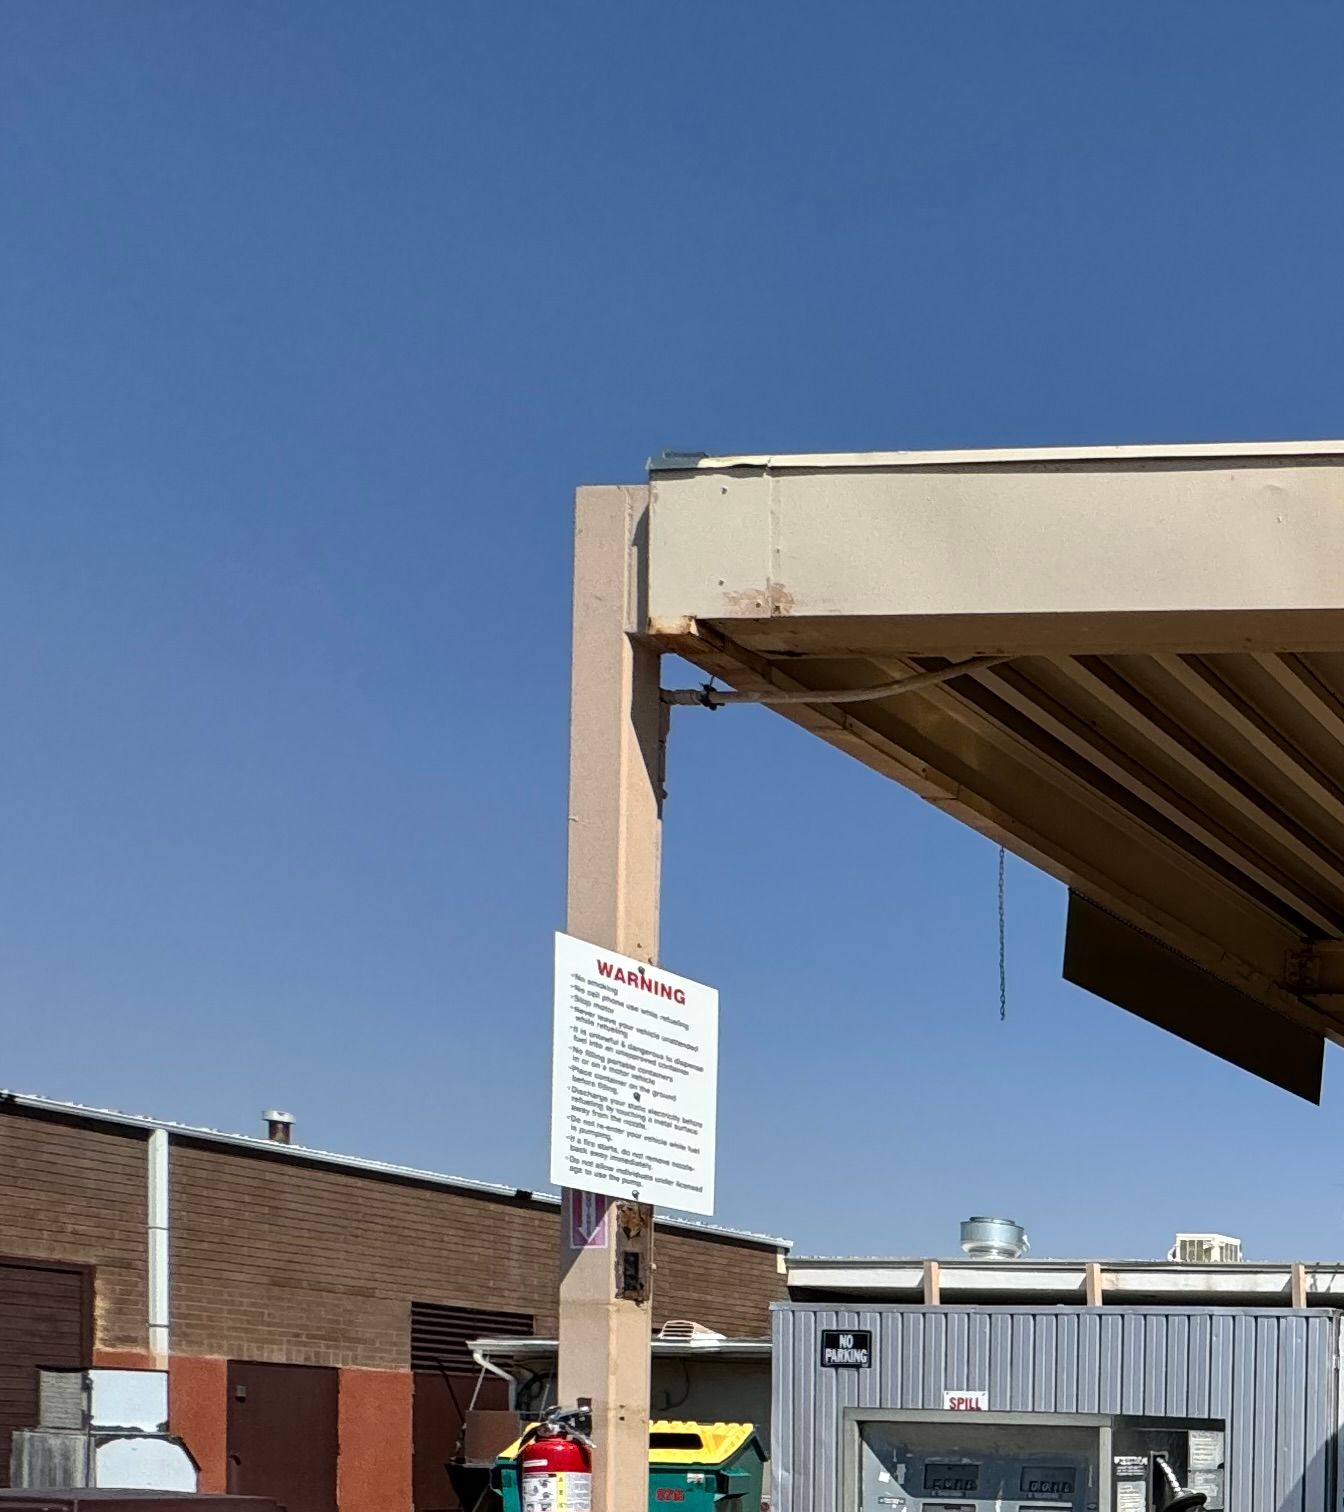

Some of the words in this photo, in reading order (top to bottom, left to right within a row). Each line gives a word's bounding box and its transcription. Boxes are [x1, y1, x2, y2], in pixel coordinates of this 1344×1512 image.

[596, 959, 686, 1006] WARNING
[635, 1027, 660, 1038] vehicle
[658, 1062, 688, 1074] container
[643, 1136, 668, 1146] vehicle
[839, 1334, 854, 1349] NO
[825, 1348, 869, 1363] PARKING
[949, 1396, 981, 1411] SPILL
